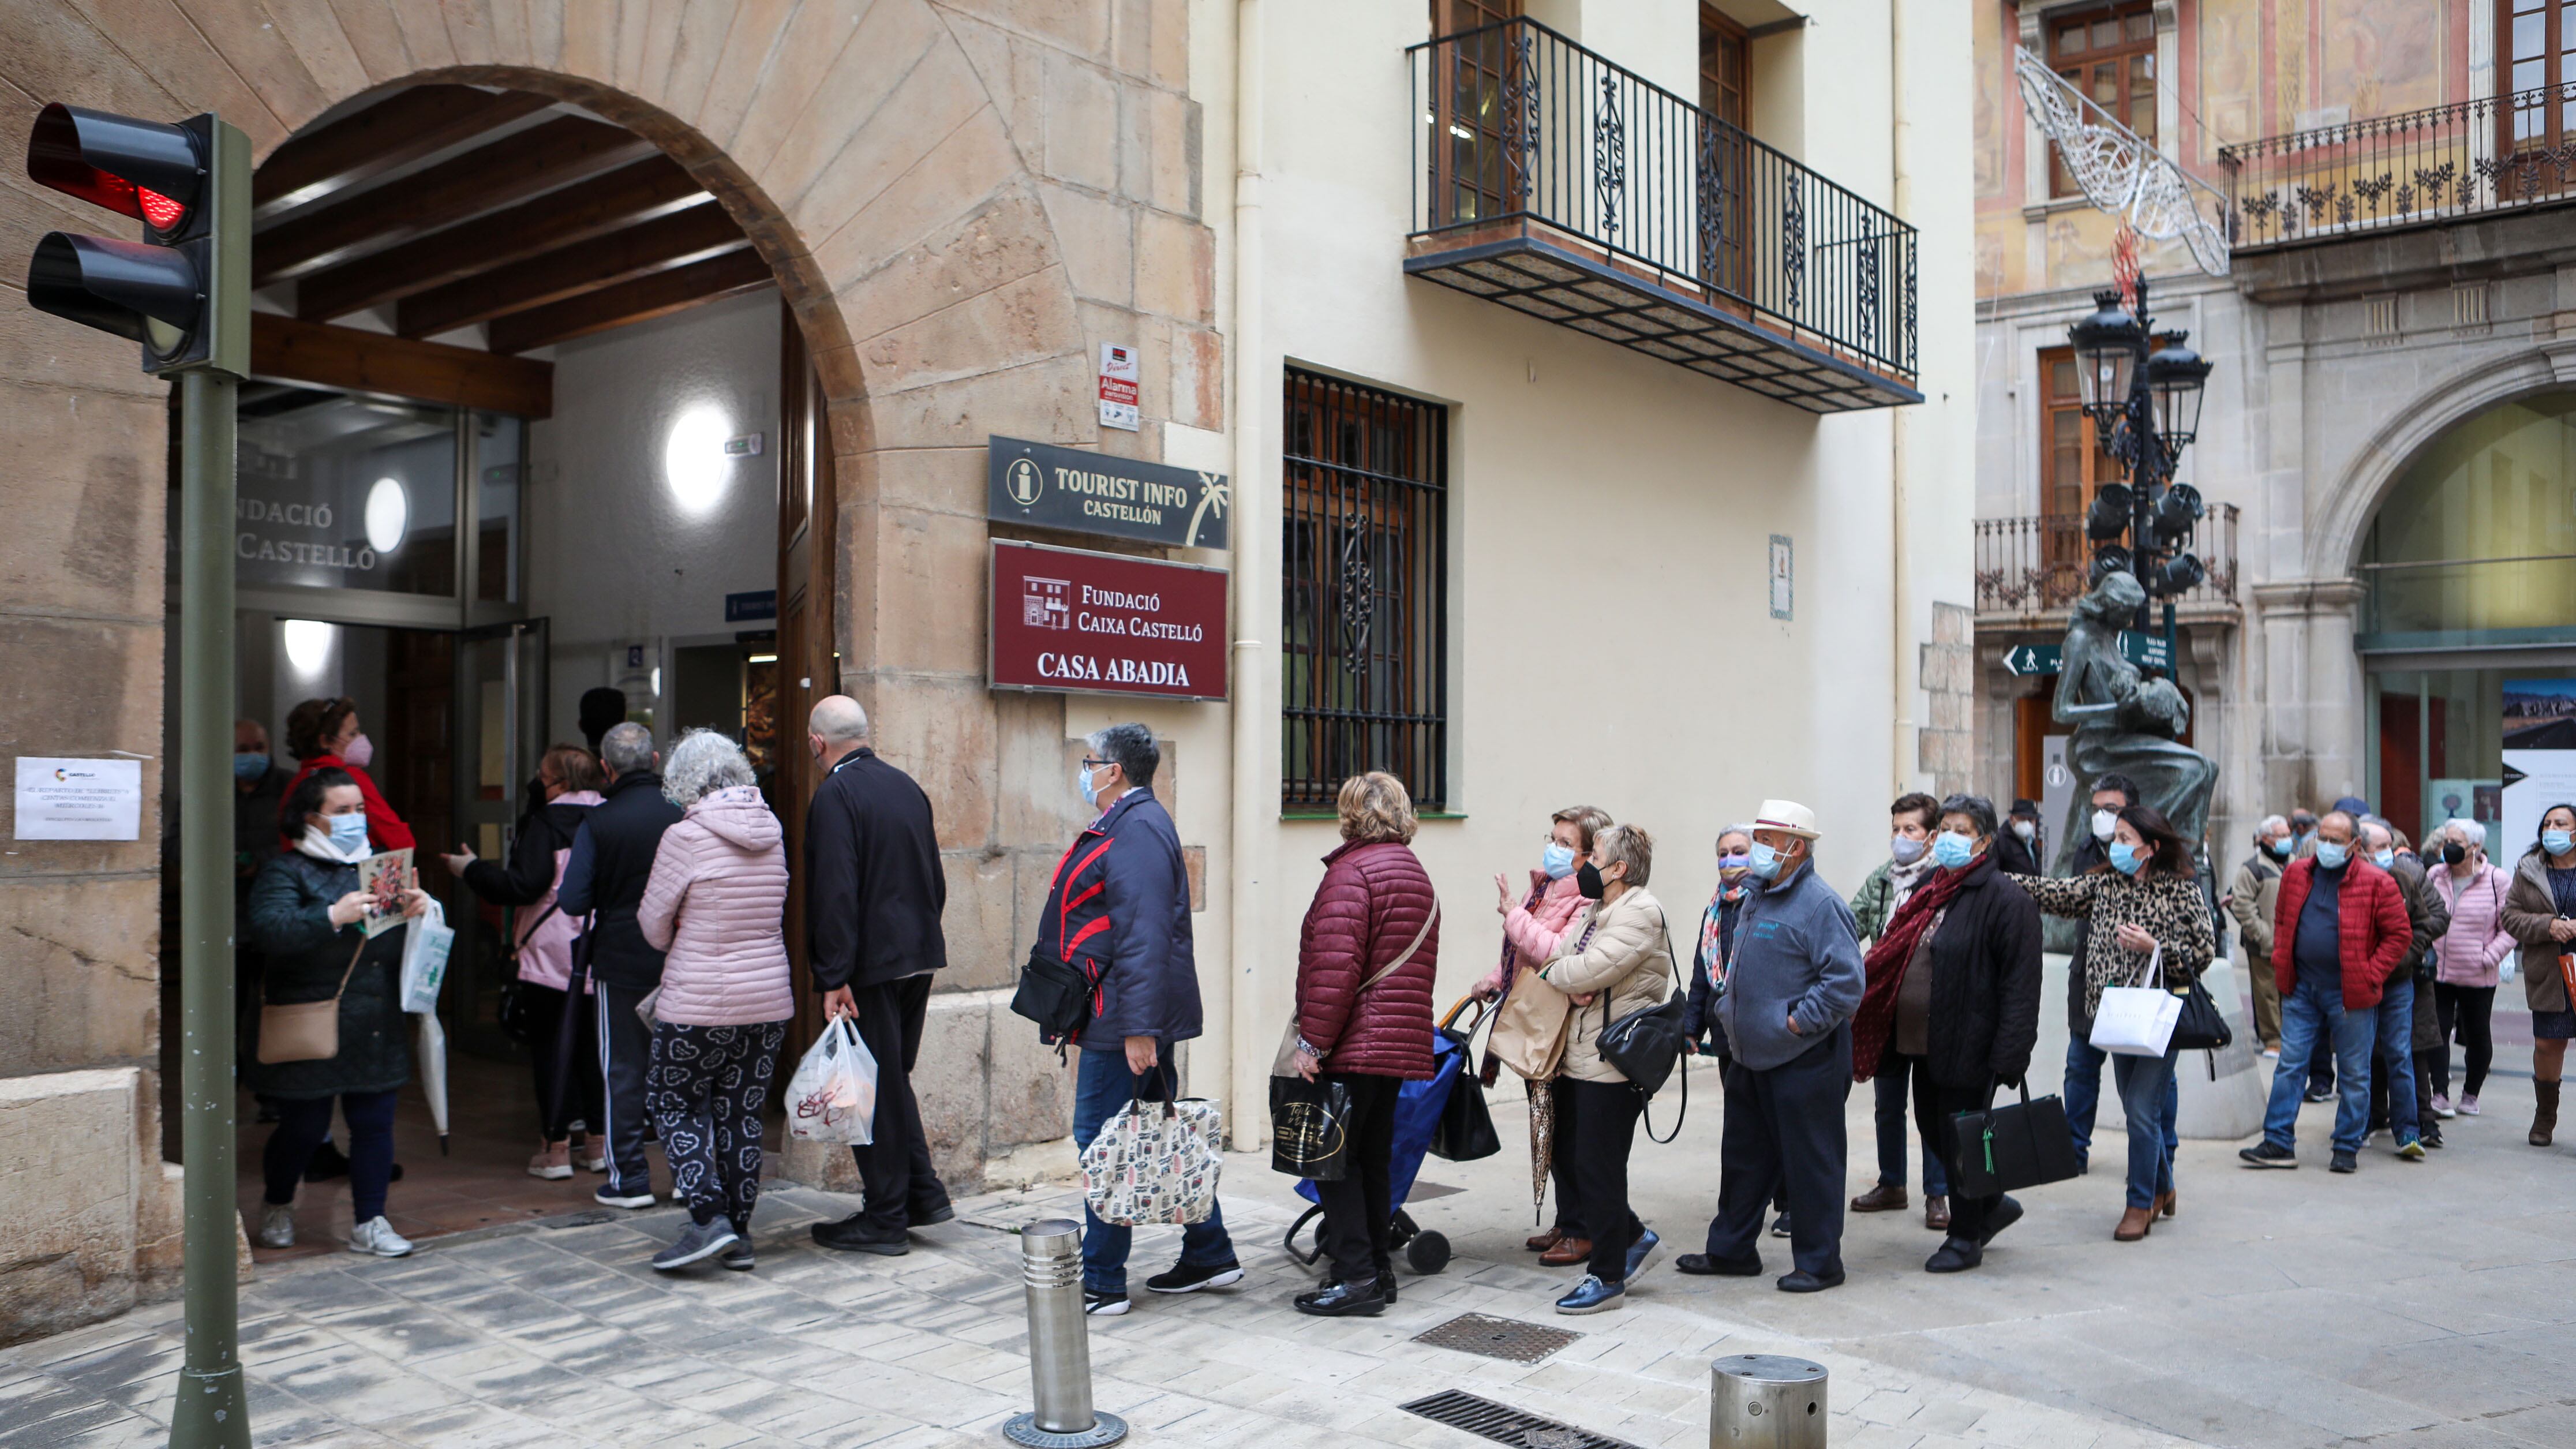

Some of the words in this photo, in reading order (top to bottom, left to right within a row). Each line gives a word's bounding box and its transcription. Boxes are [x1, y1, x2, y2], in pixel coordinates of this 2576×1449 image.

[1101, 377, 1137, 396] Alarma
[1055, 467, 1139, 501] TOURIST
[1143, 481, 1188, 508] INFO
[1083, 499, 1162, 526] CASTELLÓN
[1036, 652, 1101, 680] CASA
[1104, 657, 1190, 687] ABADIA
